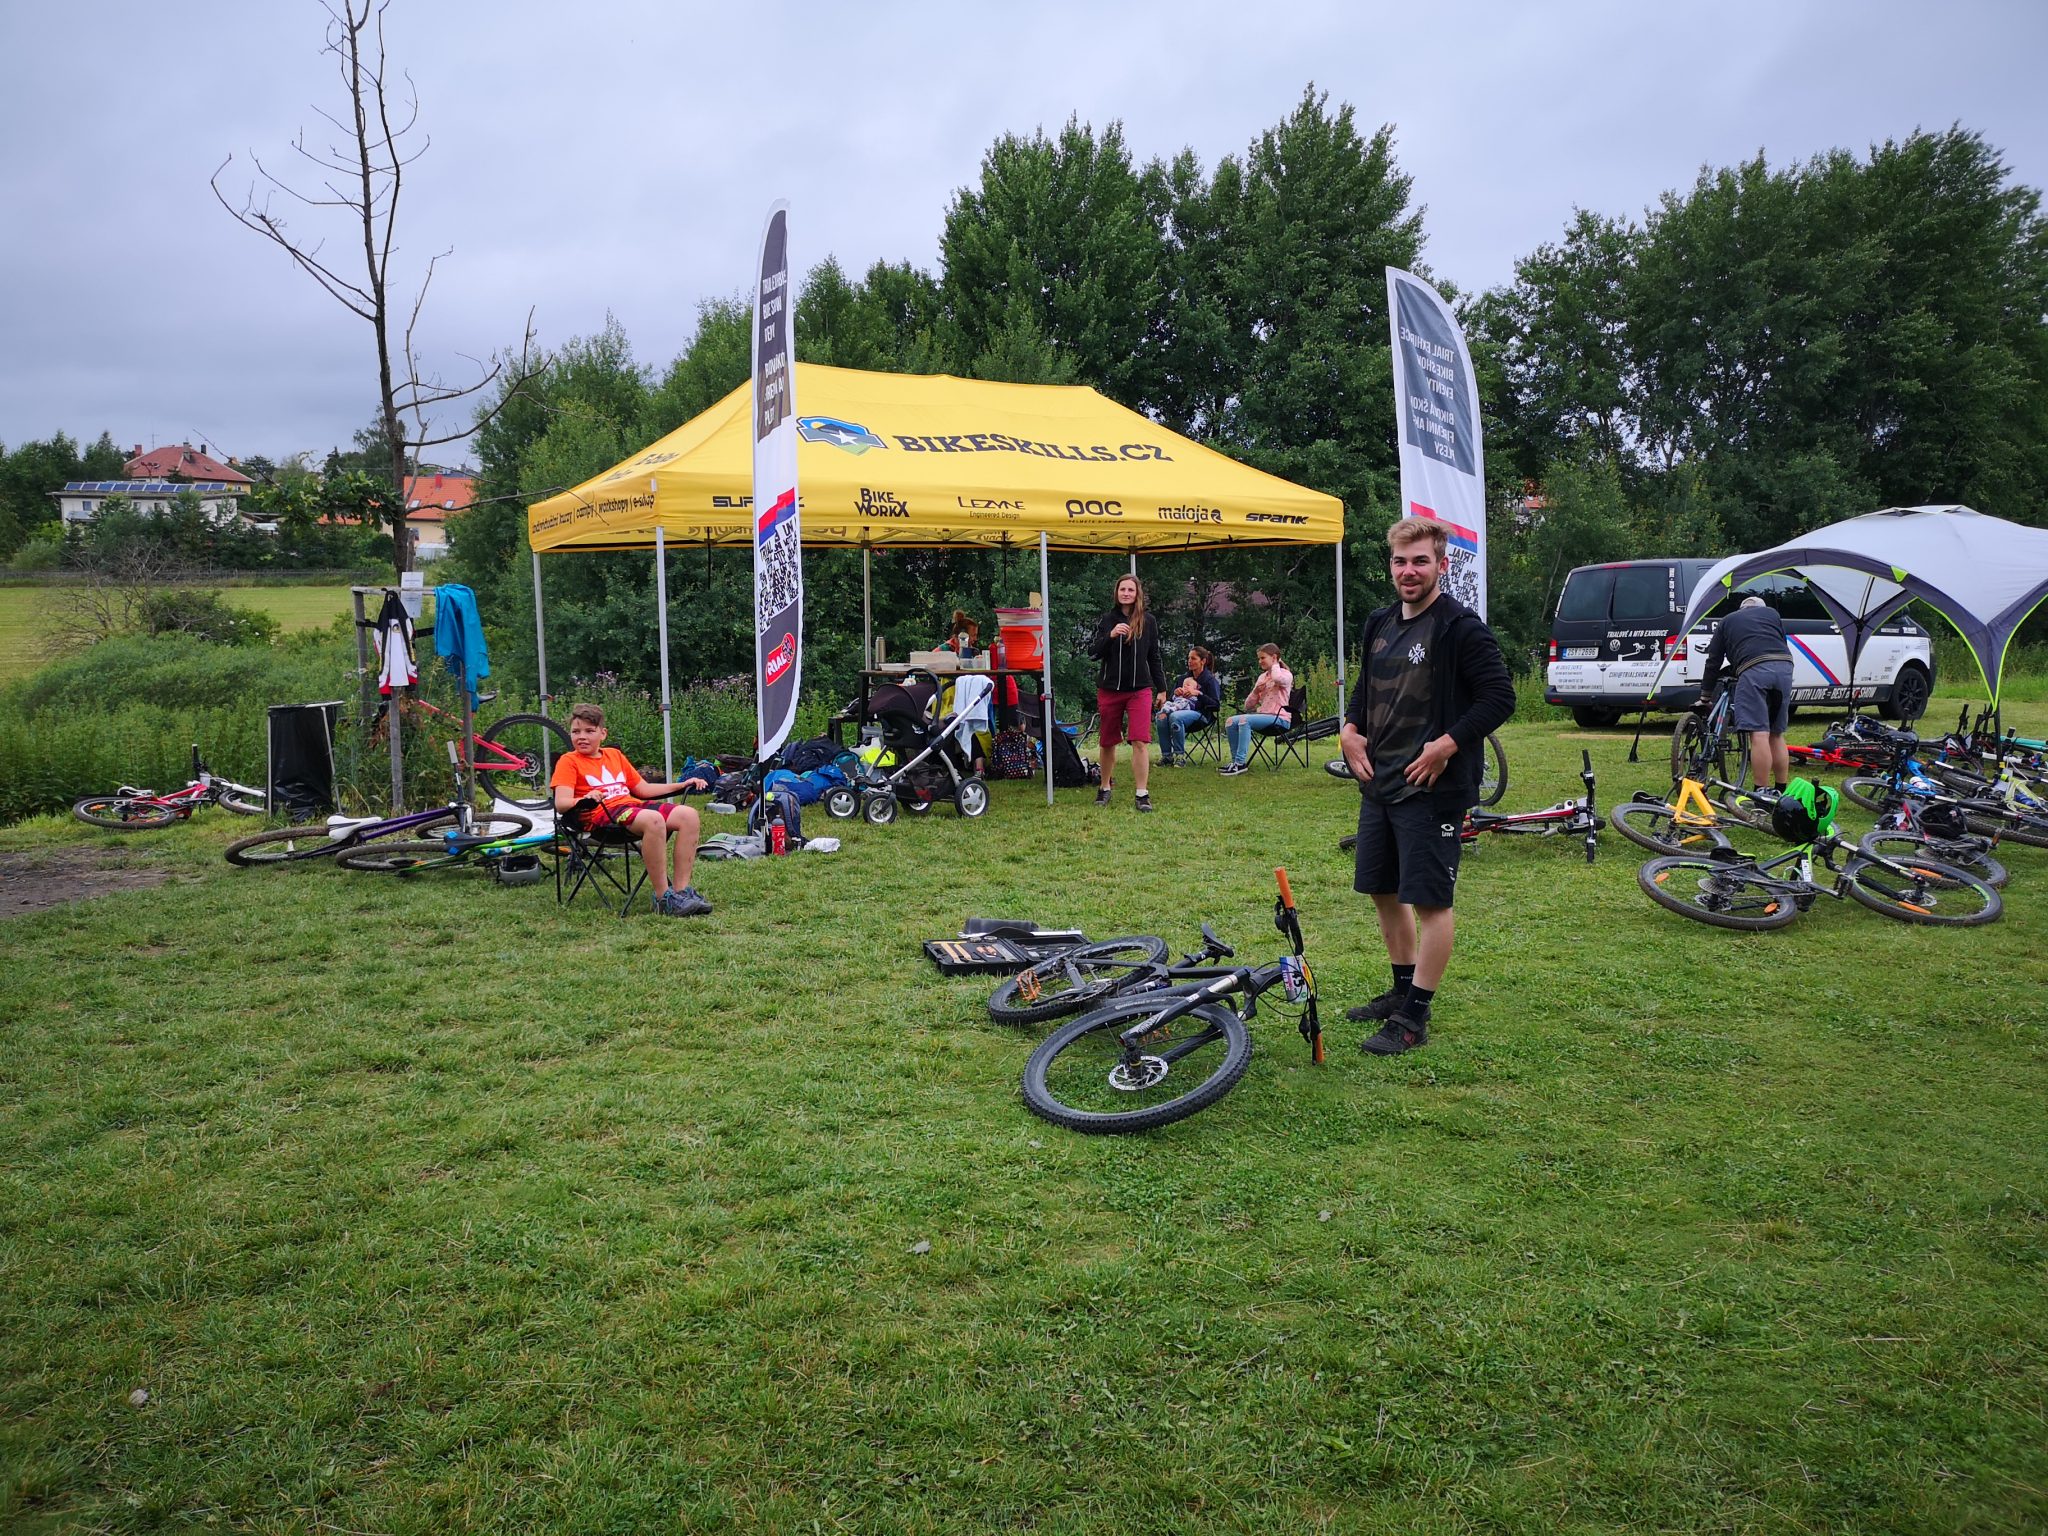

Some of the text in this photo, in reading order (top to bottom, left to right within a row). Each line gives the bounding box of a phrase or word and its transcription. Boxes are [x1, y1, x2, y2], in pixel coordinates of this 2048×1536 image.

[892, 433, 1175, 462] BIKESKILLS.CZ
[860, 487, 894, 504] BIKE
[957, 496, 1026, 510] LEZYNE
[598, 498, 628, 513] workshopy
[854, 500, 910, 518] WORKX
[1158, 505, 1208, 524] maloja
